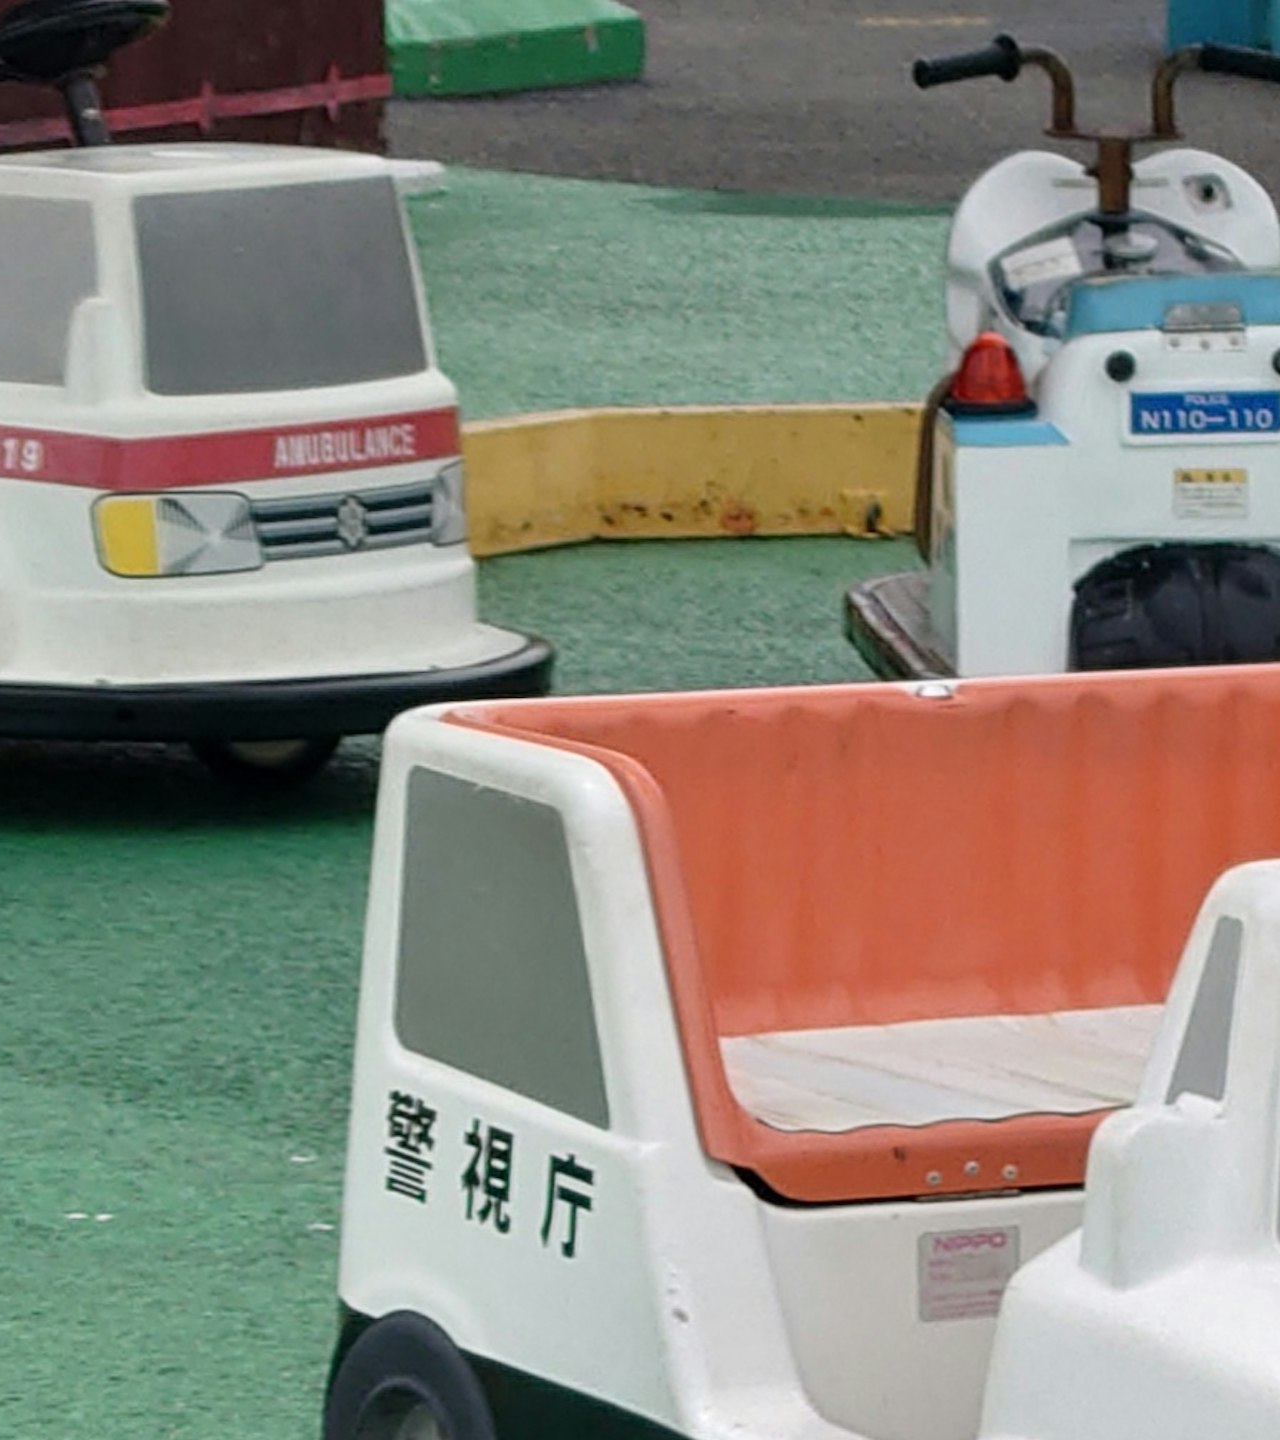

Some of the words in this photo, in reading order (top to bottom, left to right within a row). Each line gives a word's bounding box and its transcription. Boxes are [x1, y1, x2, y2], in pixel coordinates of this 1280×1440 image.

[273, 423, 417, 469] AMUBULANCE
[383, 1087, 596, 1260] 警視庁
